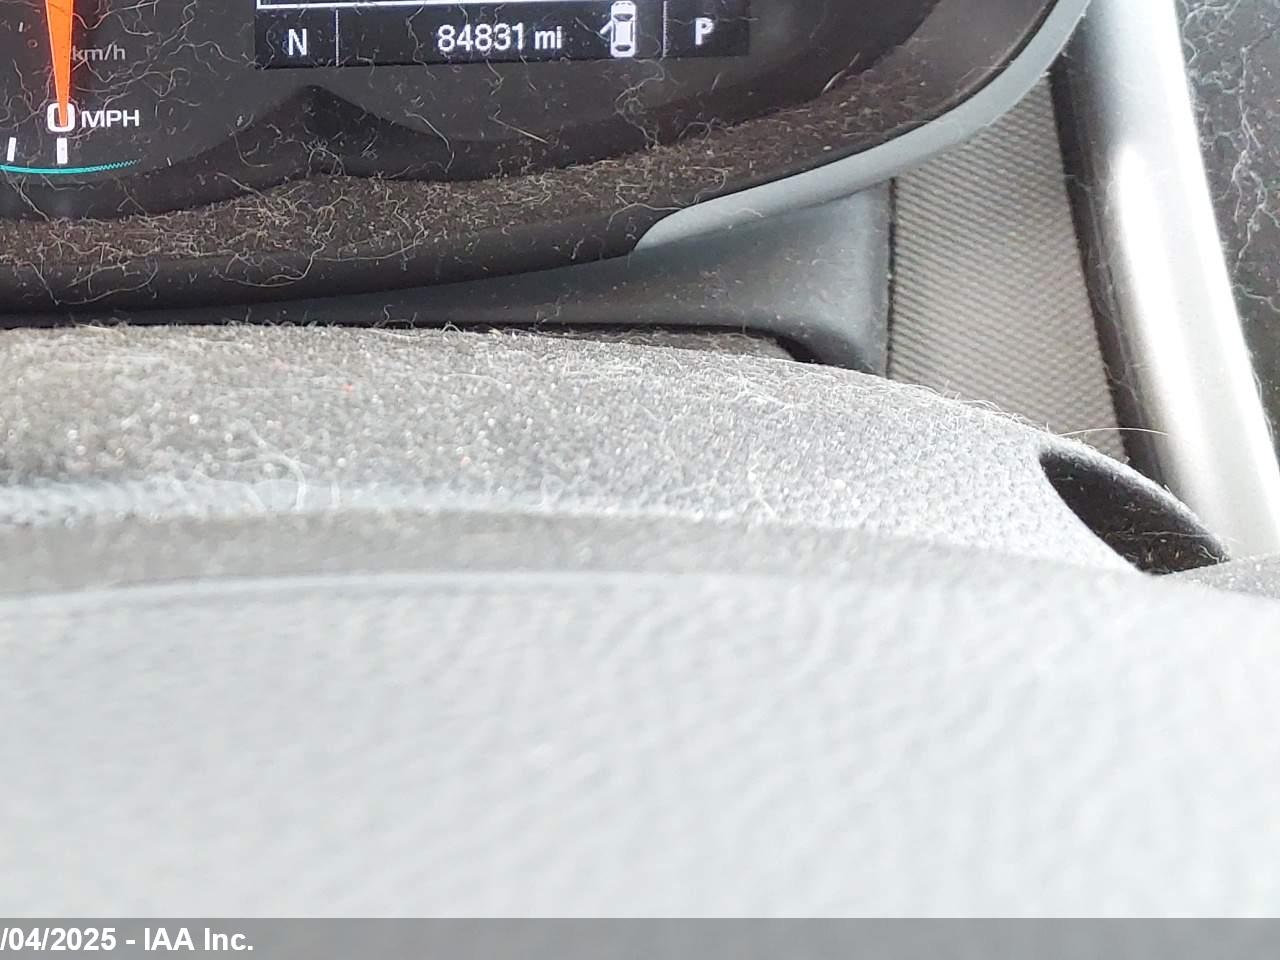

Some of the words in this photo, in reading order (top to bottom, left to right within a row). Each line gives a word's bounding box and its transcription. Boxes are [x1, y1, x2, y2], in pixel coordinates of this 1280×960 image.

[288, 29, 308, 57] N
[438, 23, 524, 52] 84831
[534, 25, 562, 50] mi
[695, 18, 714, 44] P
[72, 45, 126, 62] km/h
[47, 103, 76, 133] 0
[81, 110, 140, 128] MPH
